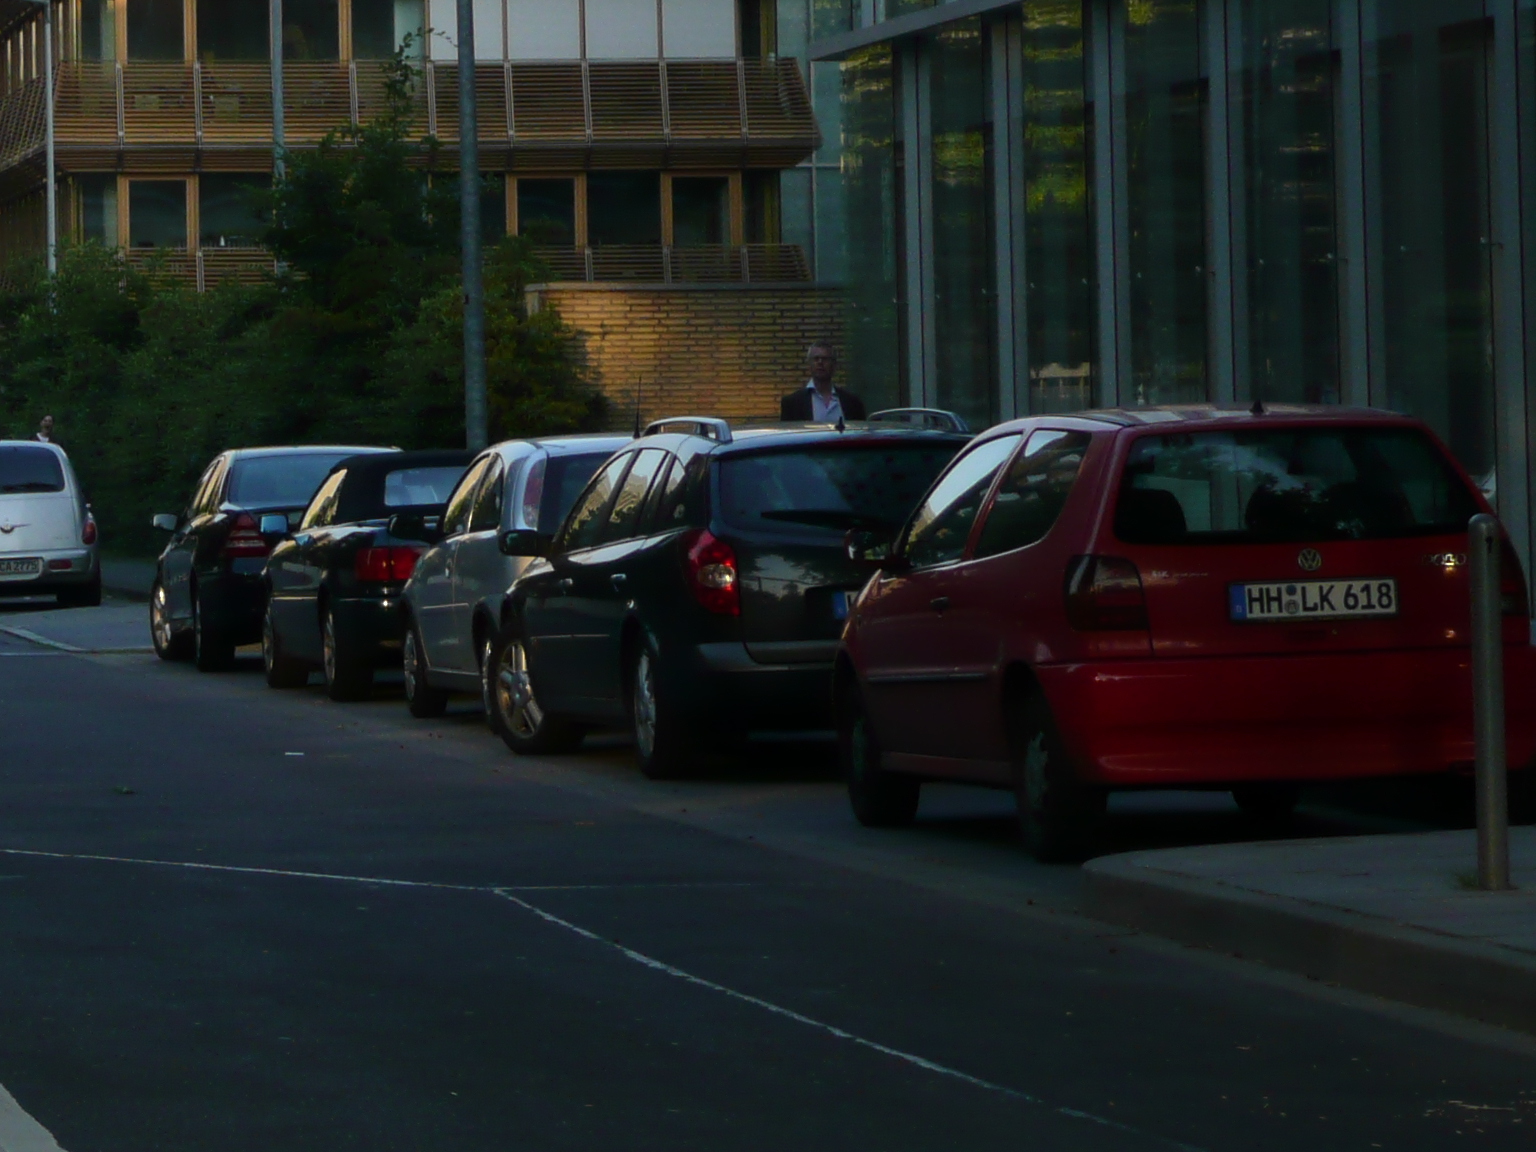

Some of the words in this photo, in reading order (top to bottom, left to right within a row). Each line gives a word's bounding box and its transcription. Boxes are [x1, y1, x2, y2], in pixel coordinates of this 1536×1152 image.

[1247, 587, 1284, 615] HH
[1301, 584, 1335, 612] LK
[1343, 581, 1393, 611] 618
